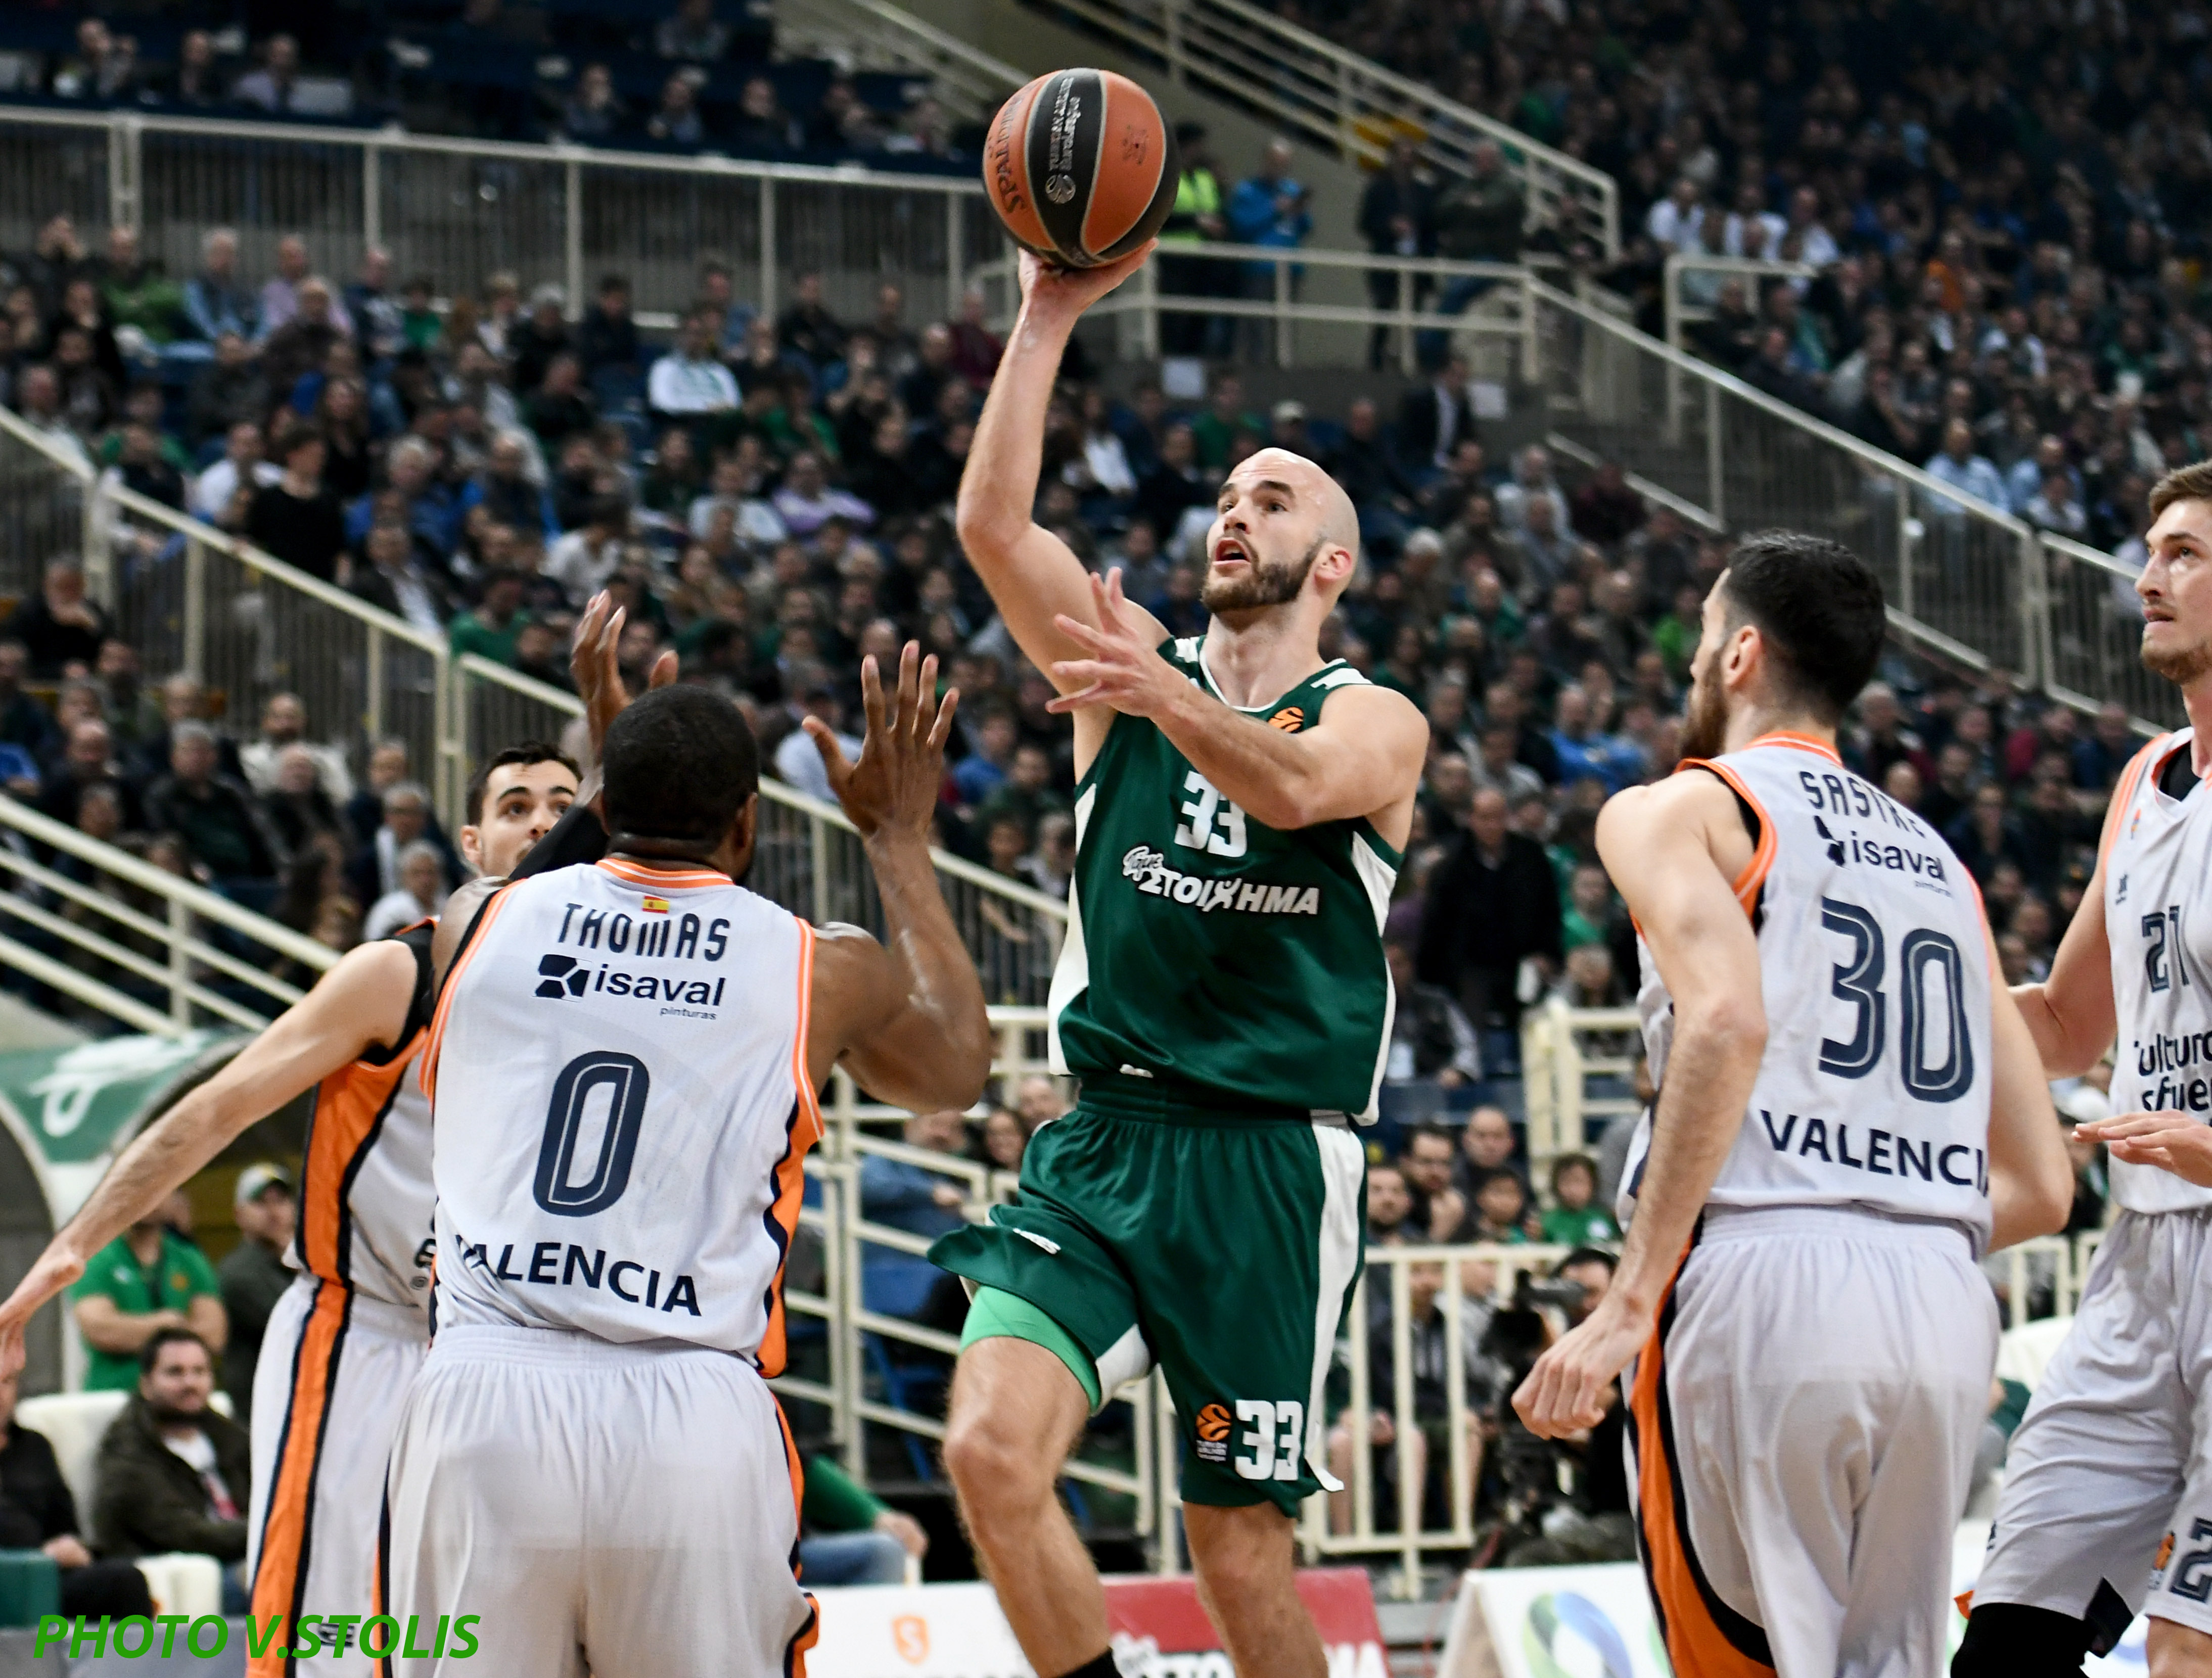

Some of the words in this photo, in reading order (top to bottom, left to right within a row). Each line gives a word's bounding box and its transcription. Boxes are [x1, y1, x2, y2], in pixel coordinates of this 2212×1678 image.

[1174, 770, 1248, 858] 33
[558, 902, 730, 962] THOMAS
[2141, 905, 2190, 993] 21
[594, 963, 726, 1006] isaval
[660, 1006, 717, 1020] pinturas
[1819, 896, 1974, 1103] 30
[532, 1050, 651, 1218] 0
[1761, 1110, 1989, 1198] VALENCI
[1234, 1399, 1304, 1481] 33
